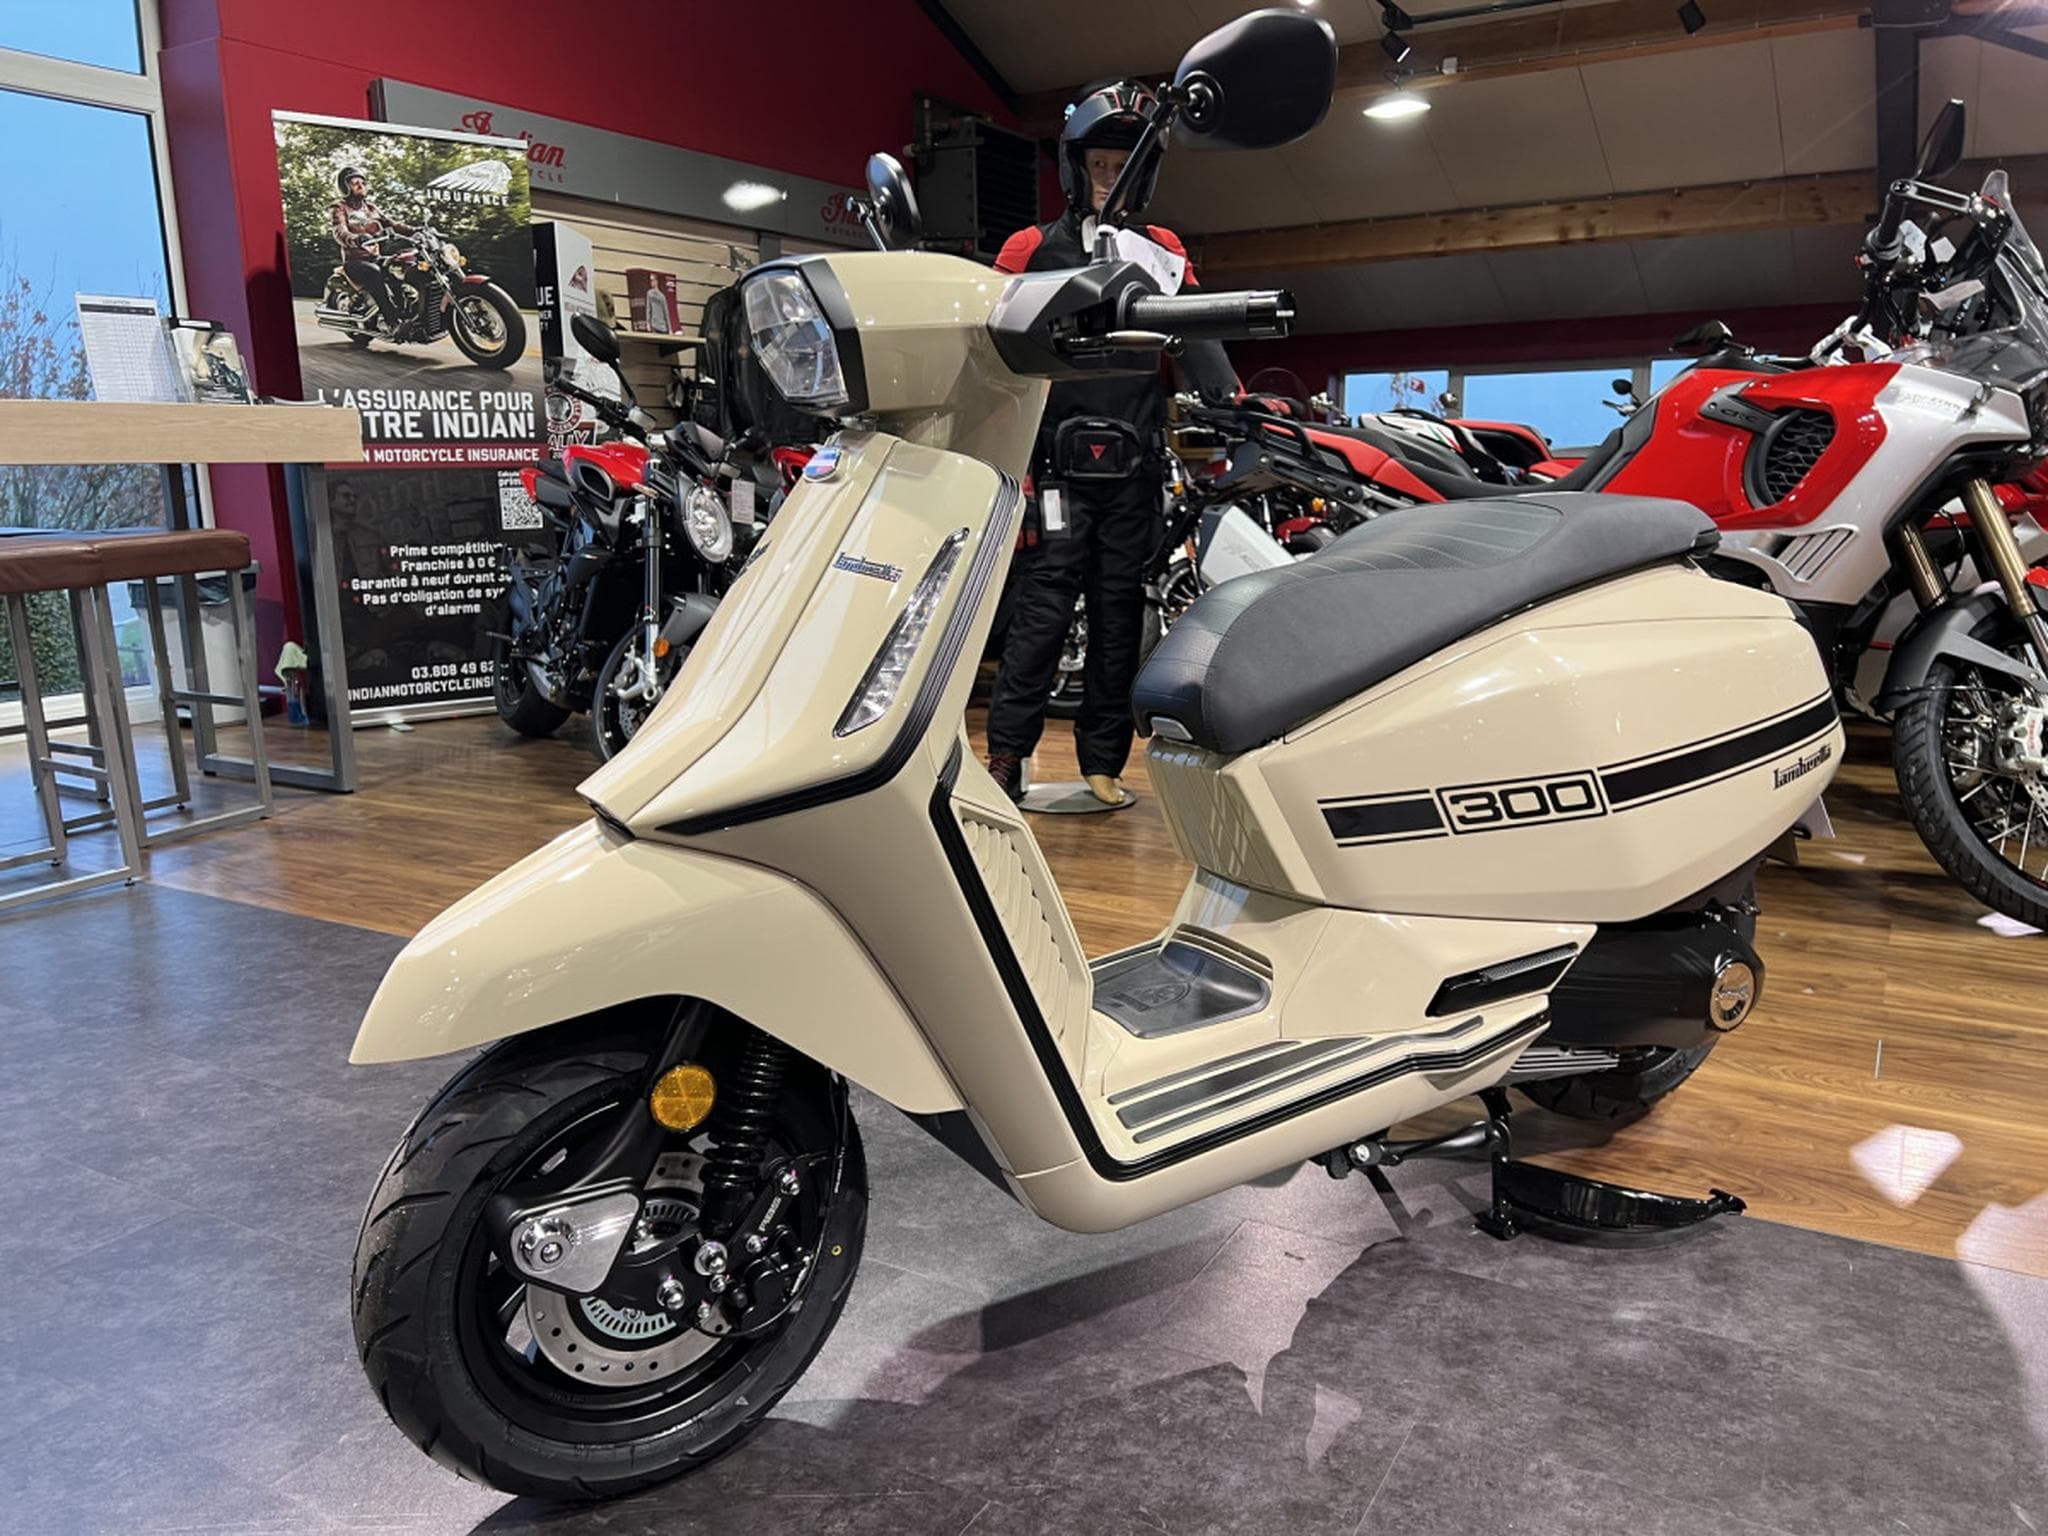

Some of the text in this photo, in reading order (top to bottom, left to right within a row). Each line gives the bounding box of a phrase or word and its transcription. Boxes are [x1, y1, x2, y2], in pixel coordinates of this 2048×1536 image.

[426, 188, 510, 208] INSURANCE
[317, 388, 474, 411] L'ASSURANCE
[480, 391, 534, 412] POUR
[362, 411, 537, 439] TRE INDIAN!
[373, 448, 465, 462] MOTORCYCLE
[467, 448, 541, 462] INSURANCE
[389, 544, 429, 558] Prime
[400, 557, 465, 573] Franchise
[466, 555, 476, 570] à
[487, 556, 497, 569] €
[351, 576, 409, 591] Garantie
[410, 573, 419, 587] à
[421, 573, 451, 587] neuf
[452, 571, 496, 585] durant
[362, 593, 388, 606] Pas
[389, 588, 465, 605] d'obligation
[466, 585, 483, 599] de
[424, 602, 482, 617] d'alarme
[459, 662, 478, 675] 49
[347, 675, 495, 702] INDIANMOTORCYCLEINS
[1448, 779, 1597, 825] 300
